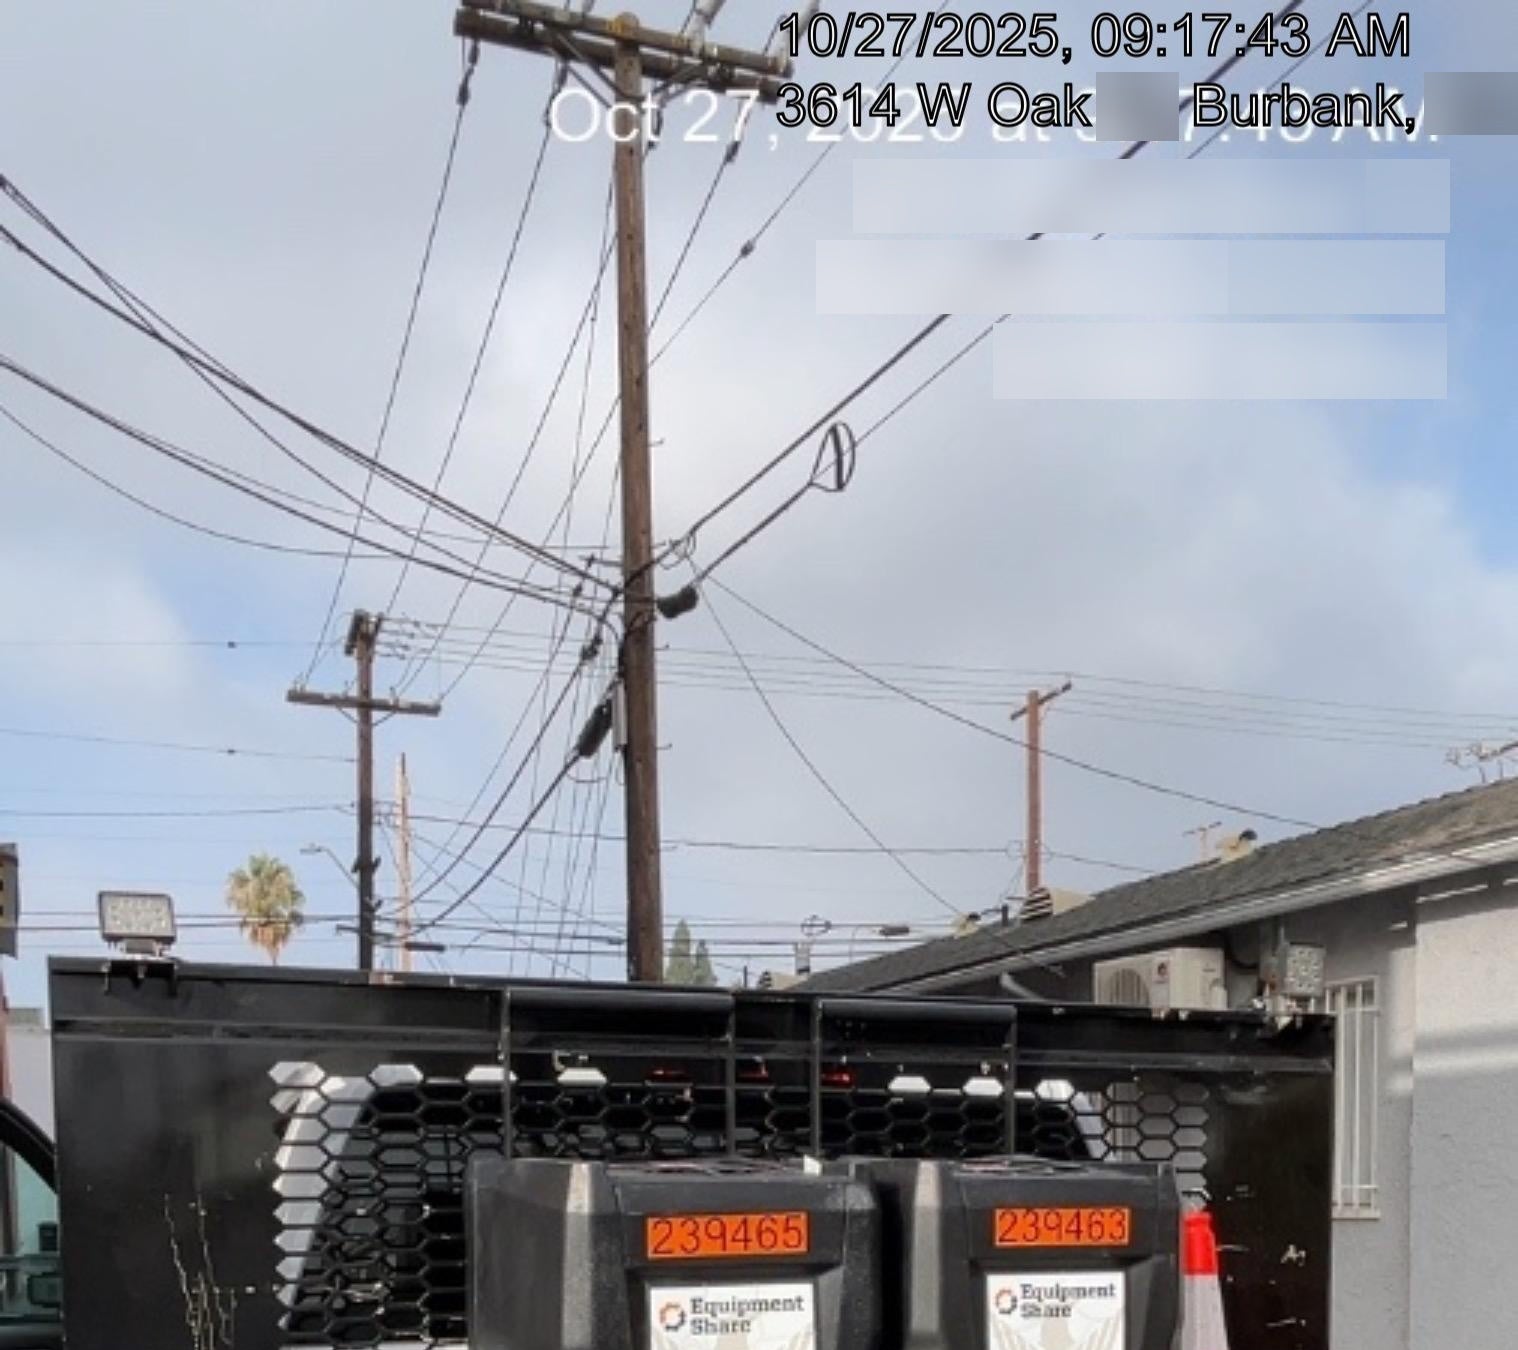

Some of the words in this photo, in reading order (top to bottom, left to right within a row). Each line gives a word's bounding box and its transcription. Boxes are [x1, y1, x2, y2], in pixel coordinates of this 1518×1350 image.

[652, 1214, 803, 1255] 239465
[997, 1209, 1127, 1244] 239463
[1020, 1283, 1117, 1304] Equipment
[690, 1295, 806, 1318] Equipment
[1020, 1302, 1073, 1318] Share
[690, 1317, 752, 1336] Share
